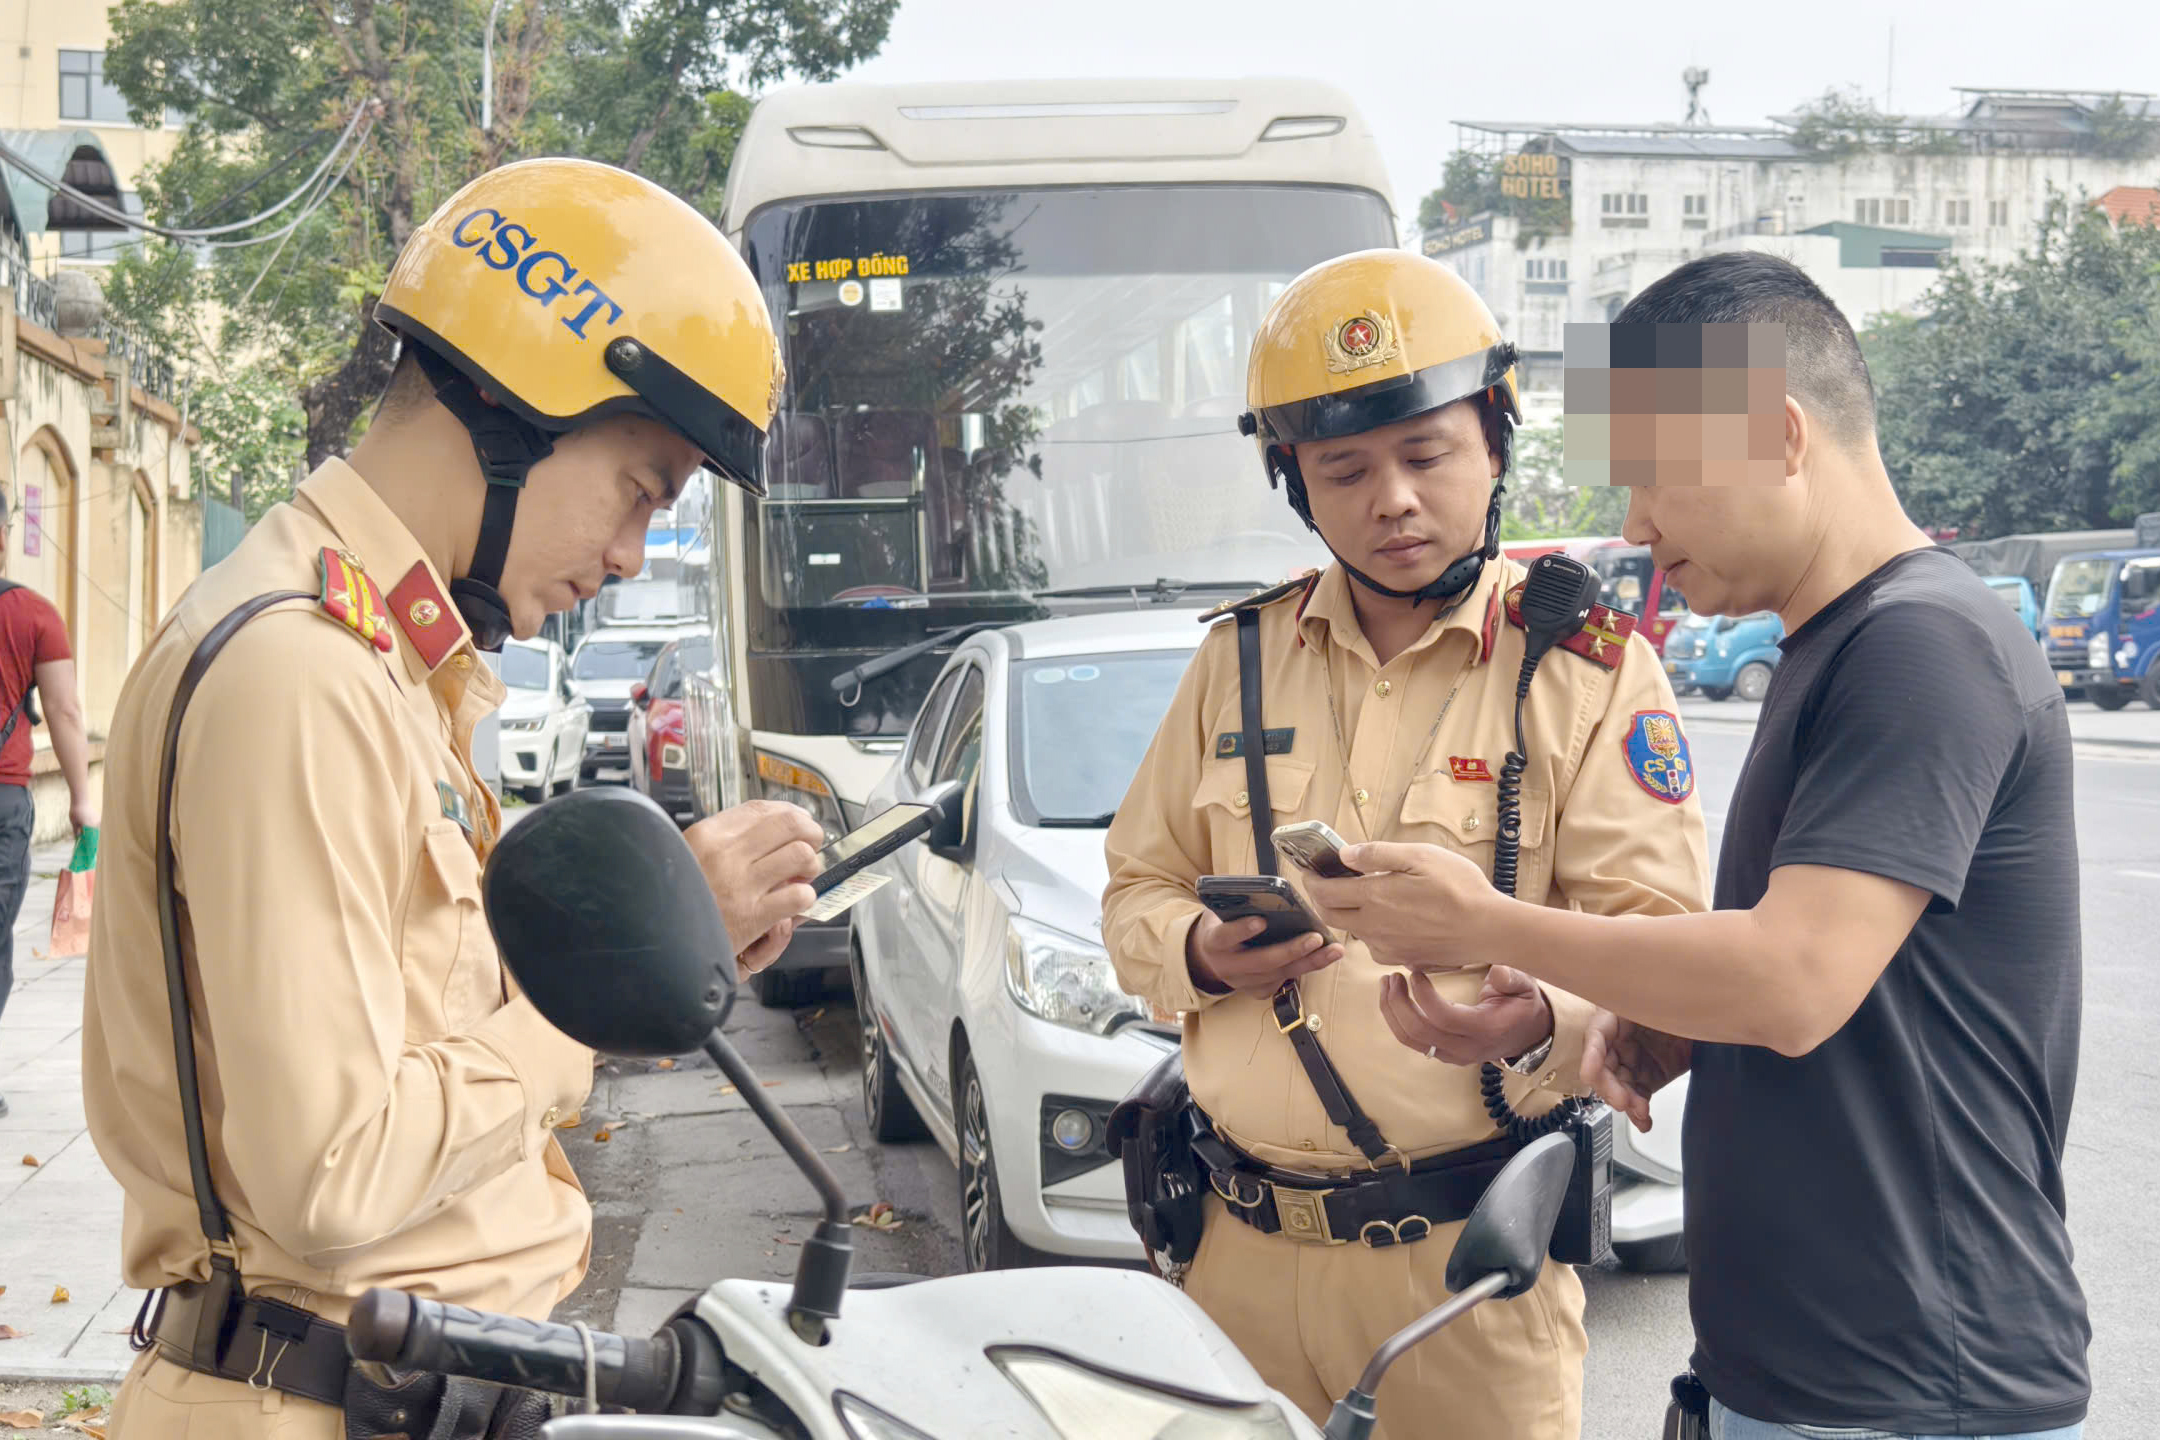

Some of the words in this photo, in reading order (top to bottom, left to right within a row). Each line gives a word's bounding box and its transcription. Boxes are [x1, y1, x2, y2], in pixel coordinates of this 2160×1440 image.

[1502, 152, 1558, 176] SOHO
[1500, 175, 1564, 199] HOTEL
[452, 208, 623, 340] CSGT
[787, 262, 811, 283] XE
[815, 258, 853, 283] HỢP
[1644, 758, 1667, 773] CS
